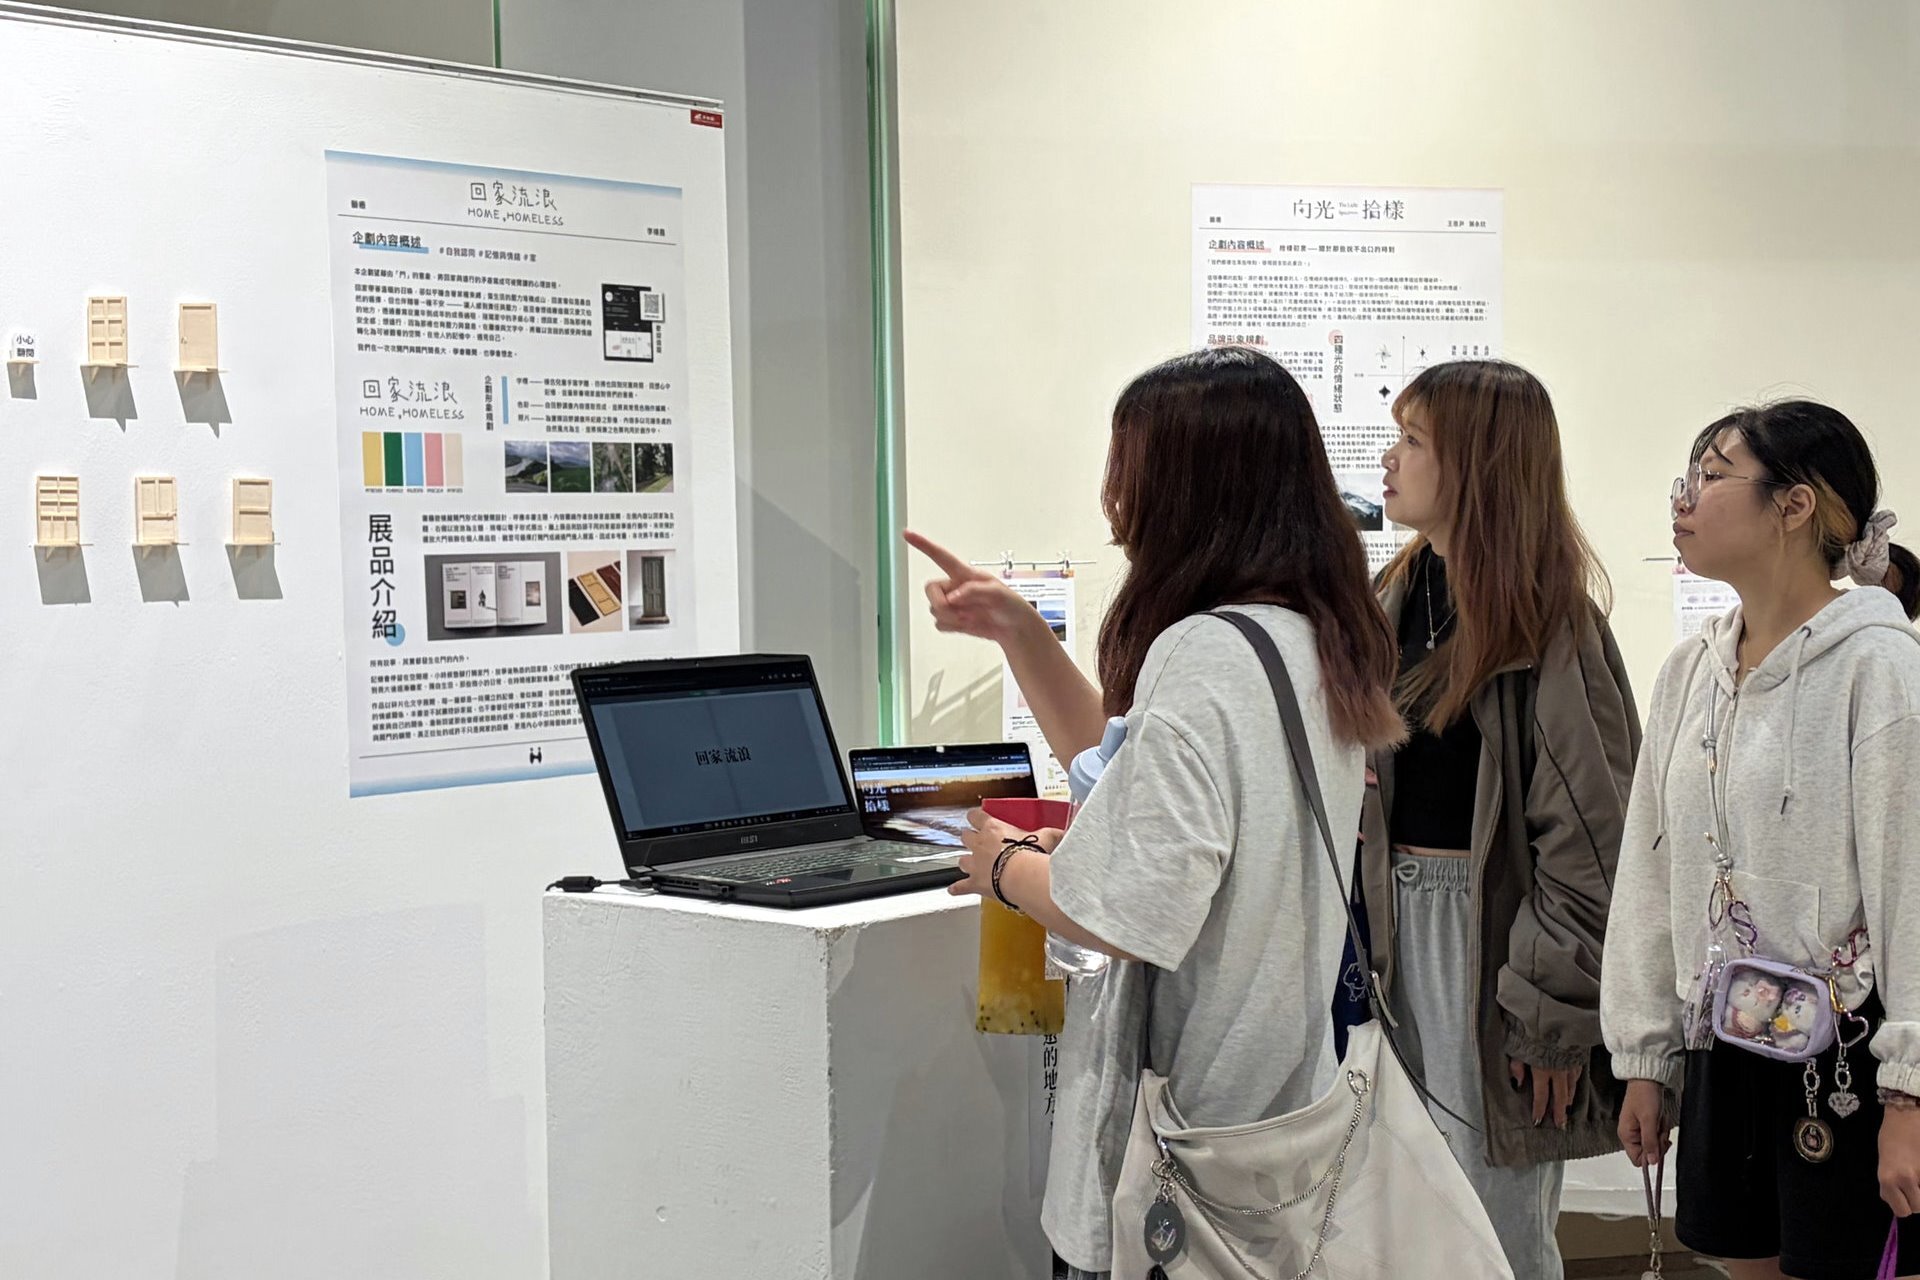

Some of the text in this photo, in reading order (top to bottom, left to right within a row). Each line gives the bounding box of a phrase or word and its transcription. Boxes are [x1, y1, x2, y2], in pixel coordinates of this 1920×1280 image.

[470, 180, 558, 211] 回家流浪
[1362, 199, 1405, 221] 拾樣
[352, 231, 422, 249] 企劃內容概述
[1208, 240, 1265, 250] 企劃內容概述
[17, 336, 33, 345] 小心
[363, 376, 458, 404] 回家流浪
[368, 513, 397, 639] 展品介紹
[695, 746, 751, 766] 回家流浪
